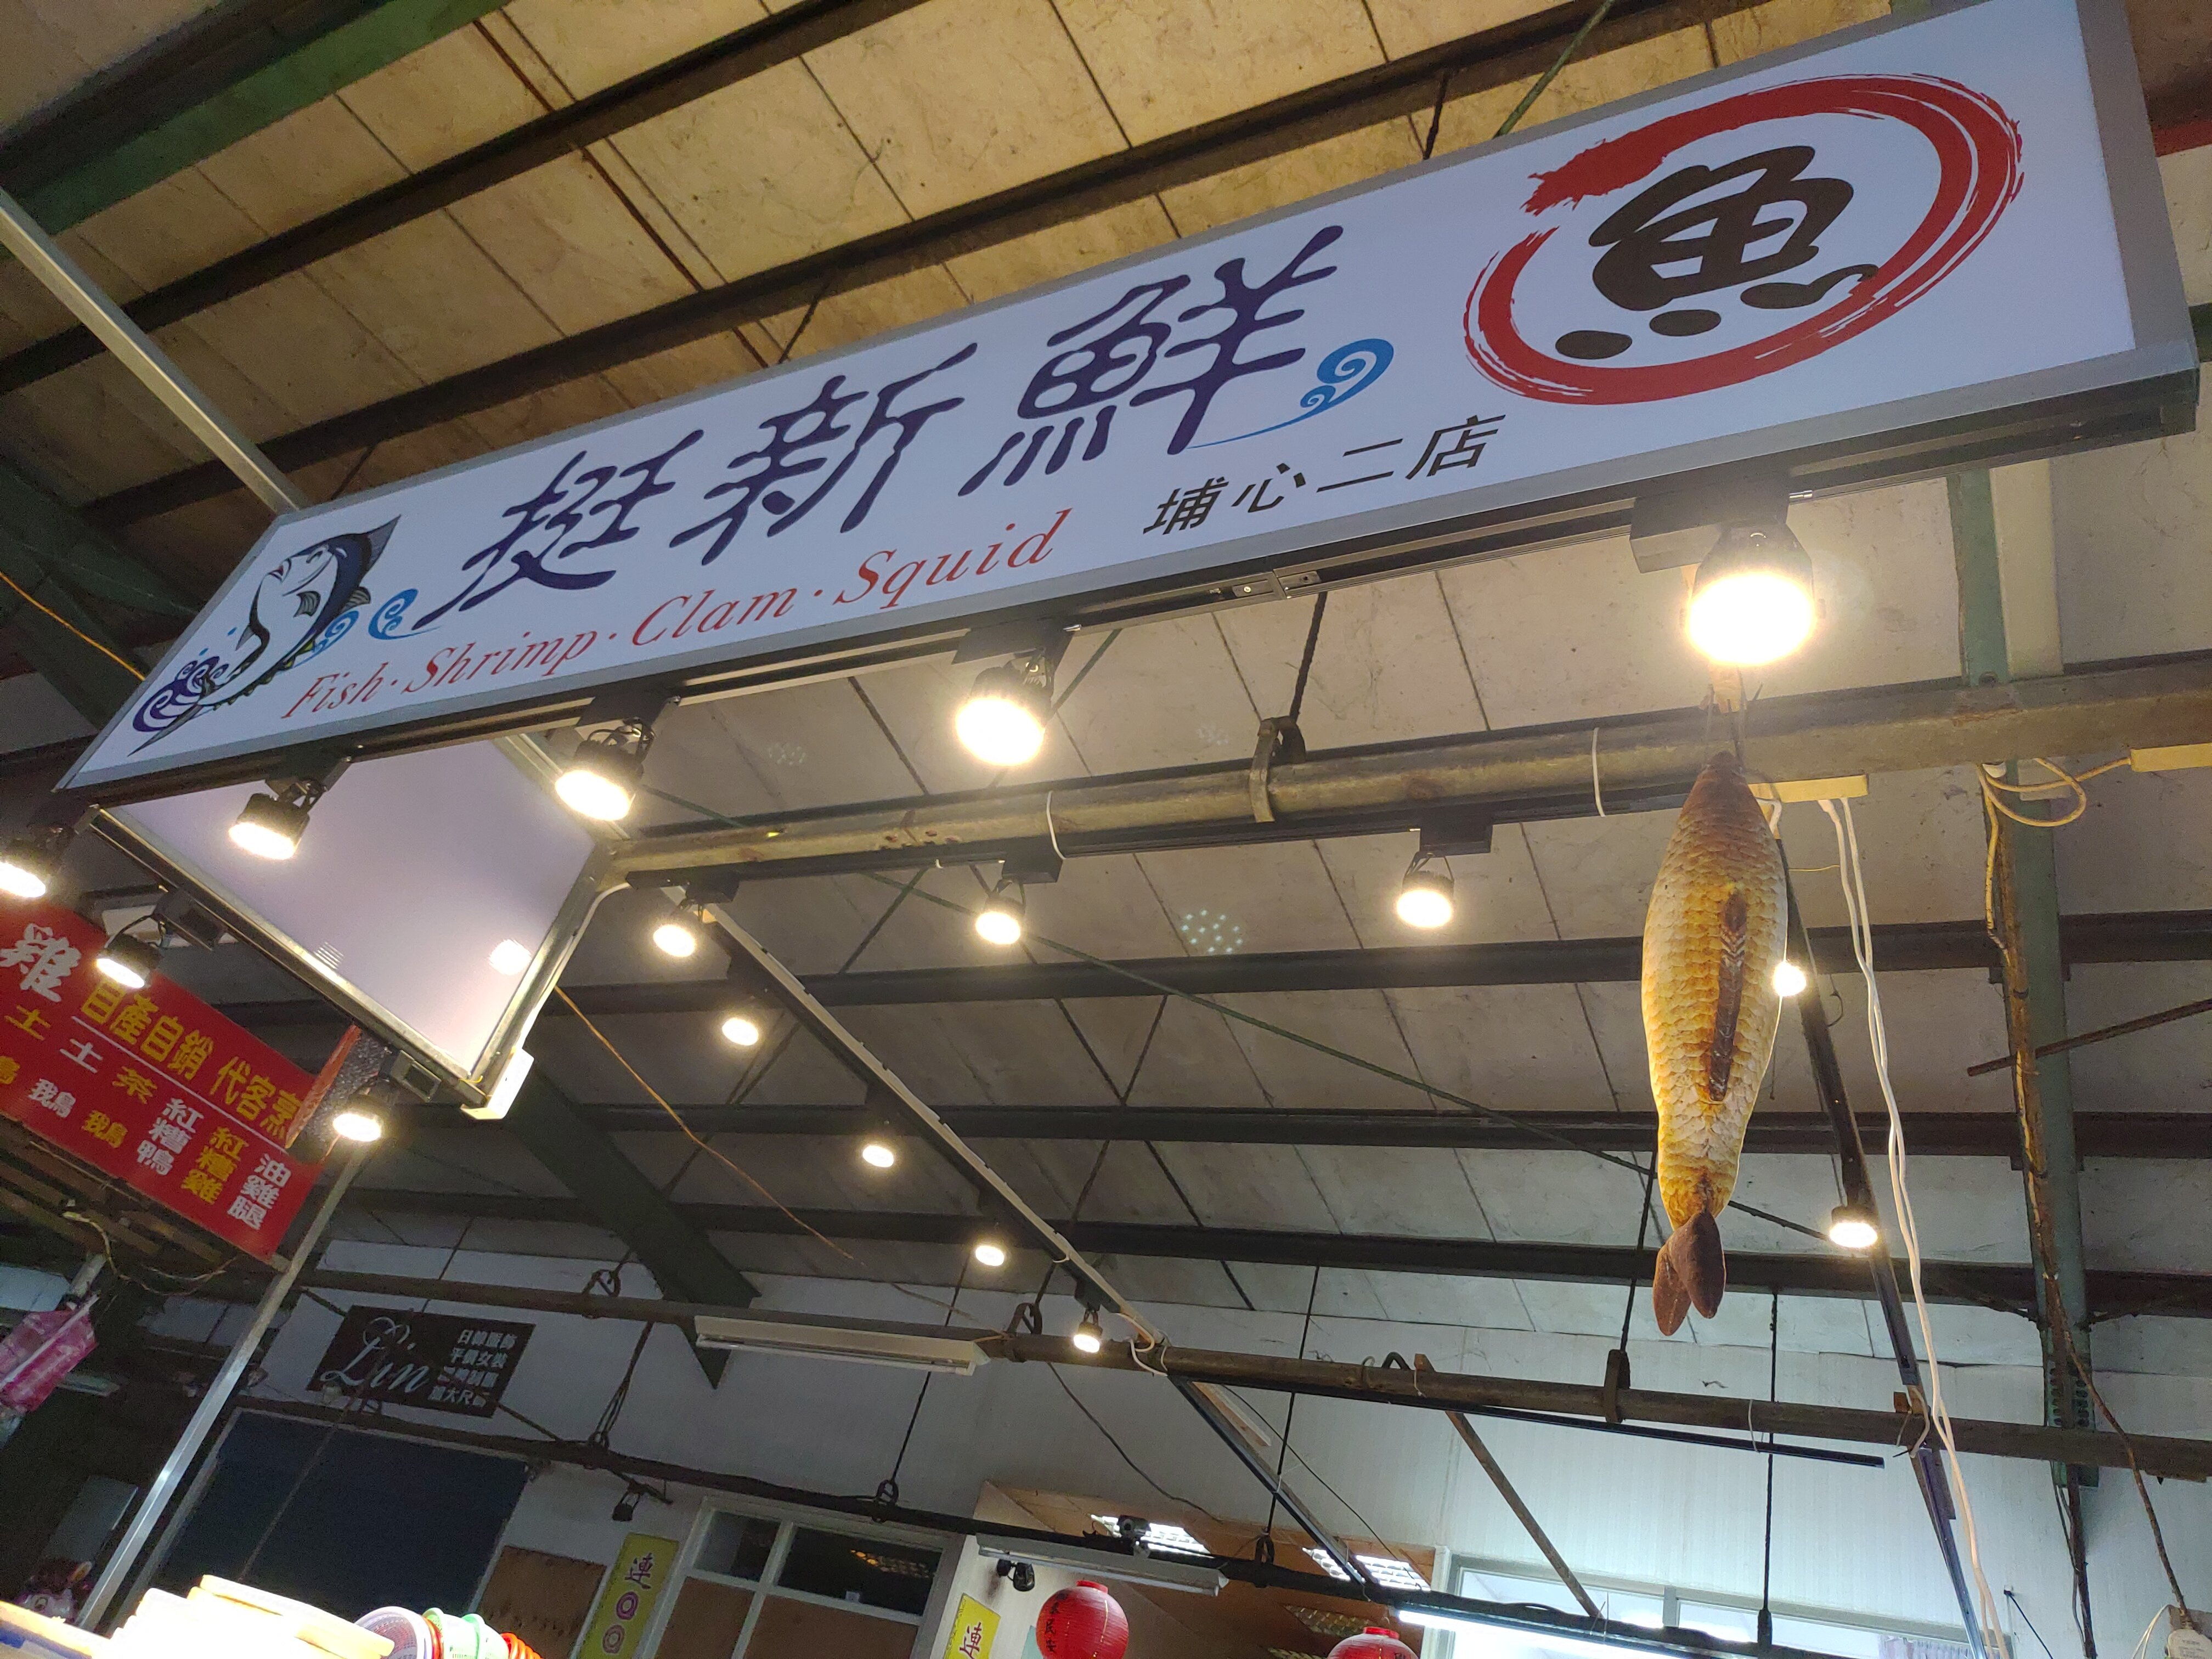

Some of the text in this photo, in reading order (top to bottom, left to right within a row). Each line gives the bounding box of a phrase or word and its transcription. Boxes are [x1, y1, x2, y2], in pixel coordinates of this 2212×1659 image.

[1555, 145, 1879, 359] 魚
[411, 225, 1343, 631] 挺新鮮
[1143, 415, 1505, 534] 埔心二店
[281, 507, 1073, 719] Fish Shrimp Clam Squid
[136, 1097, 205, 1176] 紅糟鴨
[181, 1126, 250, 1205] 紅糟雞
[227, 1153, 291, 1231] 油雞腿
